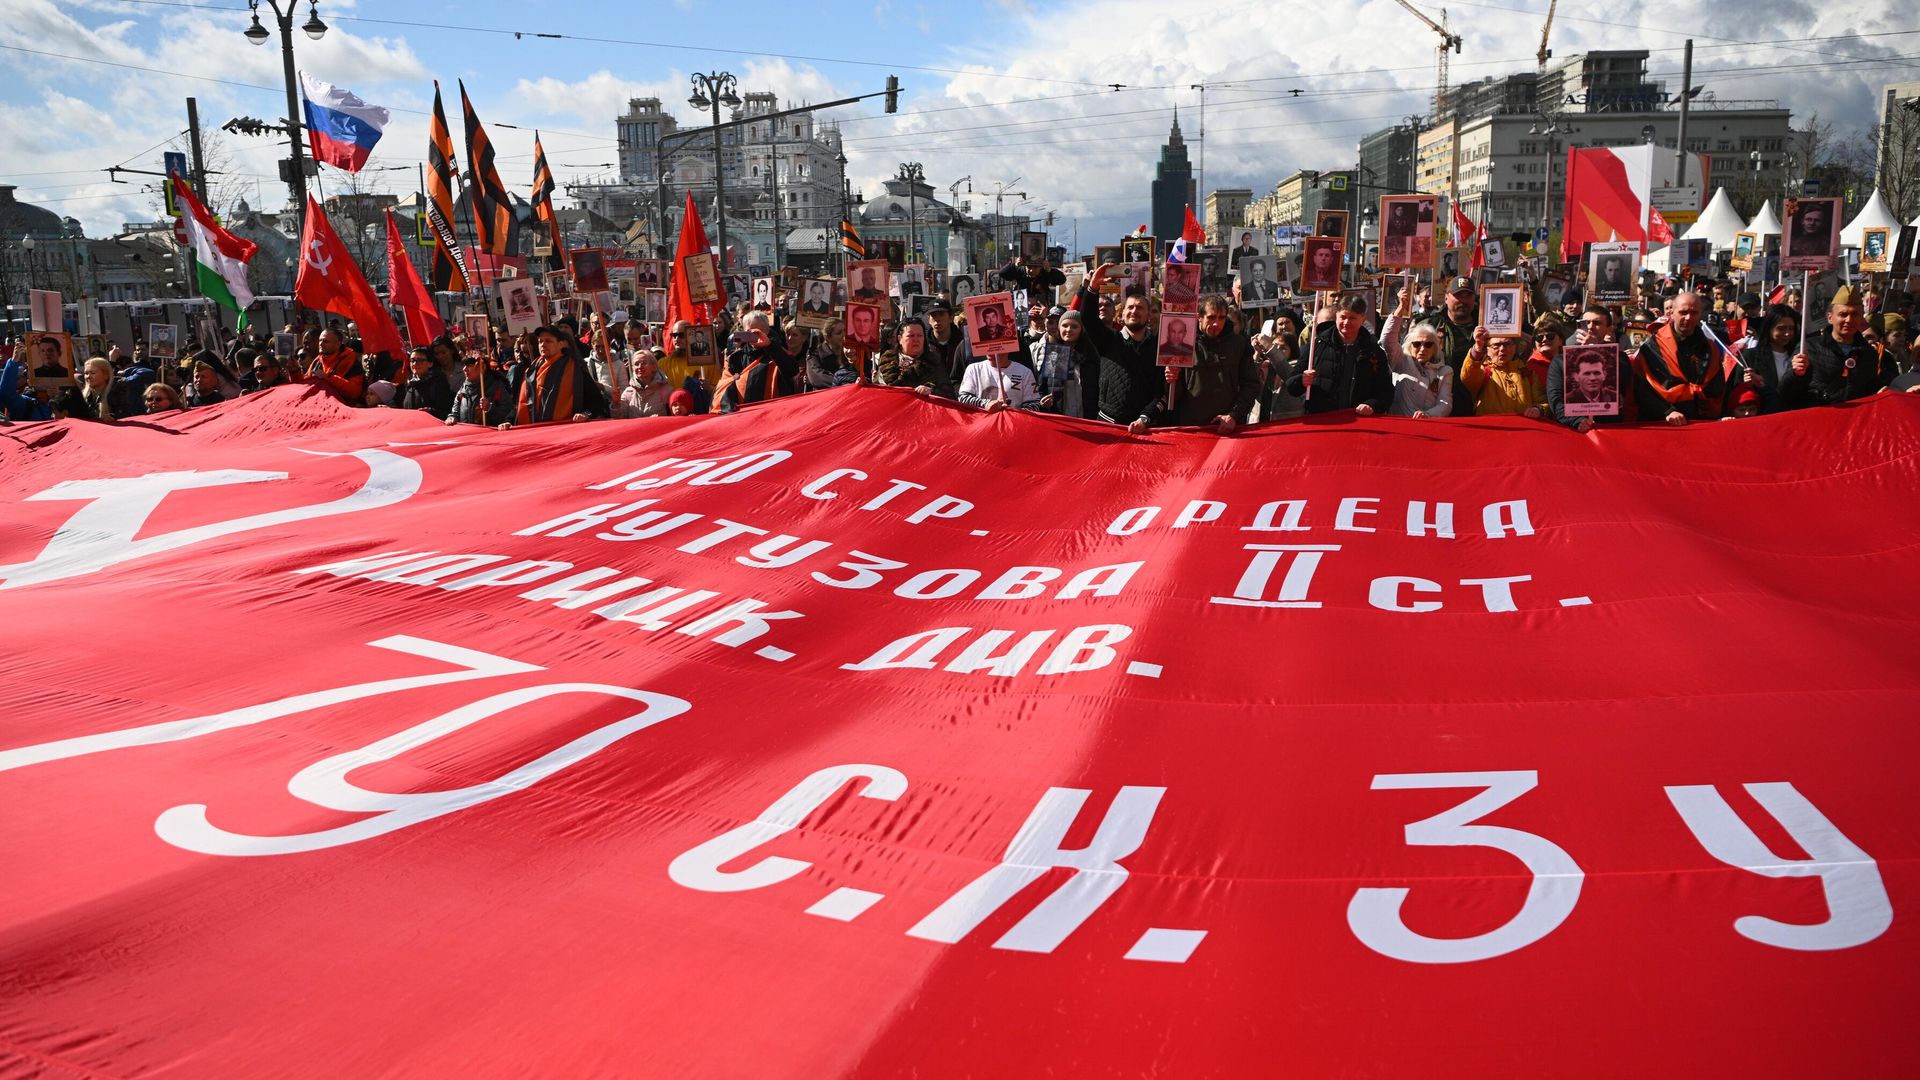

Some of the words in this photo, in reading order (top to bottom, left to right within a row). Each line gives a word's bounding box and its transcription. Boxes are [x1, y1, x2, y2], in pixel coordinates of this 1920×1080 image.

[586, 450, 793, 491] 150
[801, 468, 990, 537] СТР.
[1106, 497, 1535, 539] ОРДЕНА
[290, 550, 805, 662] ИДРИЦК.
[839, 623, 1163, 678] ДИВ.
[511, 498, 1146, 600] КУТУЗОВА
[1368, 574, 1593, 613] СТ.
[1347, 770, 1585, 964] 3
[1664, 781, 1894, 951] У
